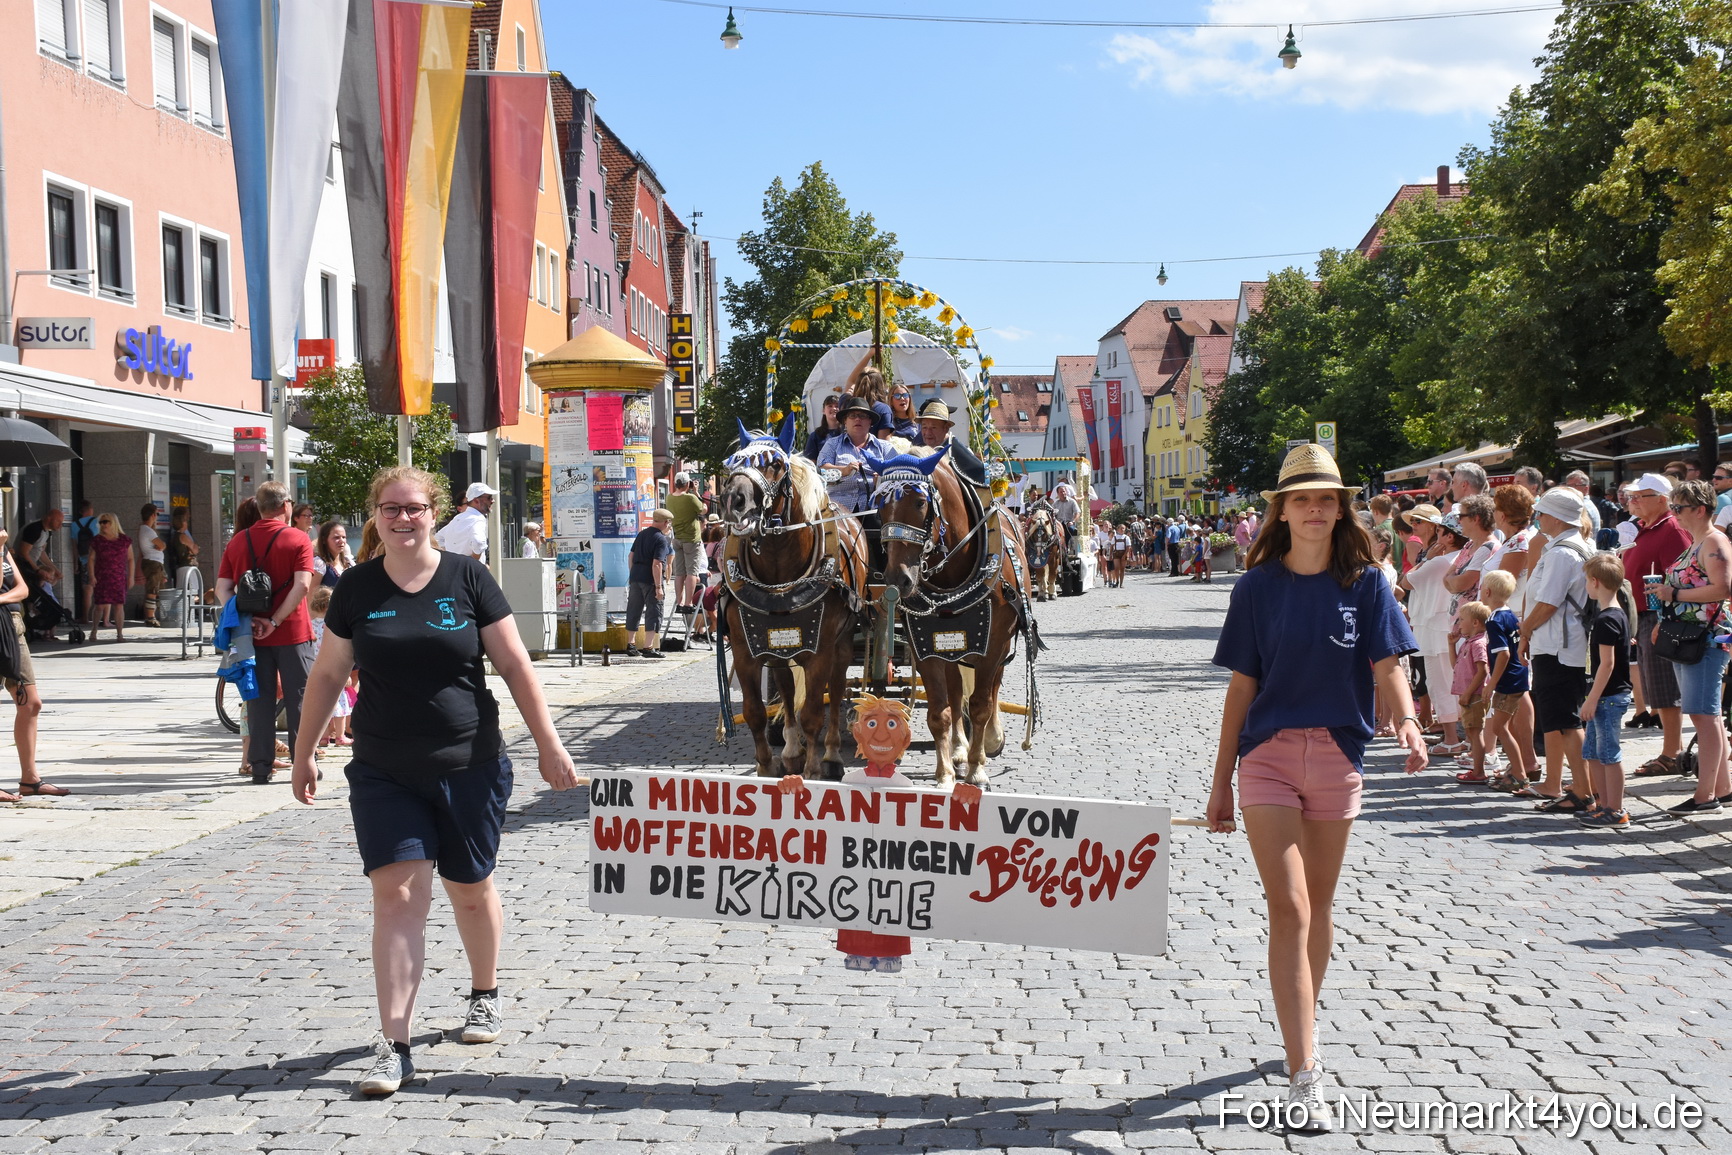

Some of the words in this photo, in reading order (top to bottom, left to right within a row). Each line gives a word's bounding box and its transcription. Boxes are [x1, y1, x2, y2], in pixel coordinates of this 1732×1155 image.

[20, 322, 88, 342] sutor.
[123, 325, 193, 380] sutor.
[671, 316, 693, 433] HOTEL
[1109, 383, 1117, 404] K&L
[367, 610, 396, 619] Johanna
[590, 777, 634, 807] WIR
[648, 776, 980, 832] MINISTRANTEN
[998, 806, 1080, 840] VON
[594, 815, 828, 866] WOFFENBACH
[842, 836, 975, 876] BRINGEN
[968, 832, 1161, 909] BEWEGUNG
[593, 862, 626, 895] IN
[650, 864, 705, 900] DIE
[715, 862, 935, 931] KIRCHE
